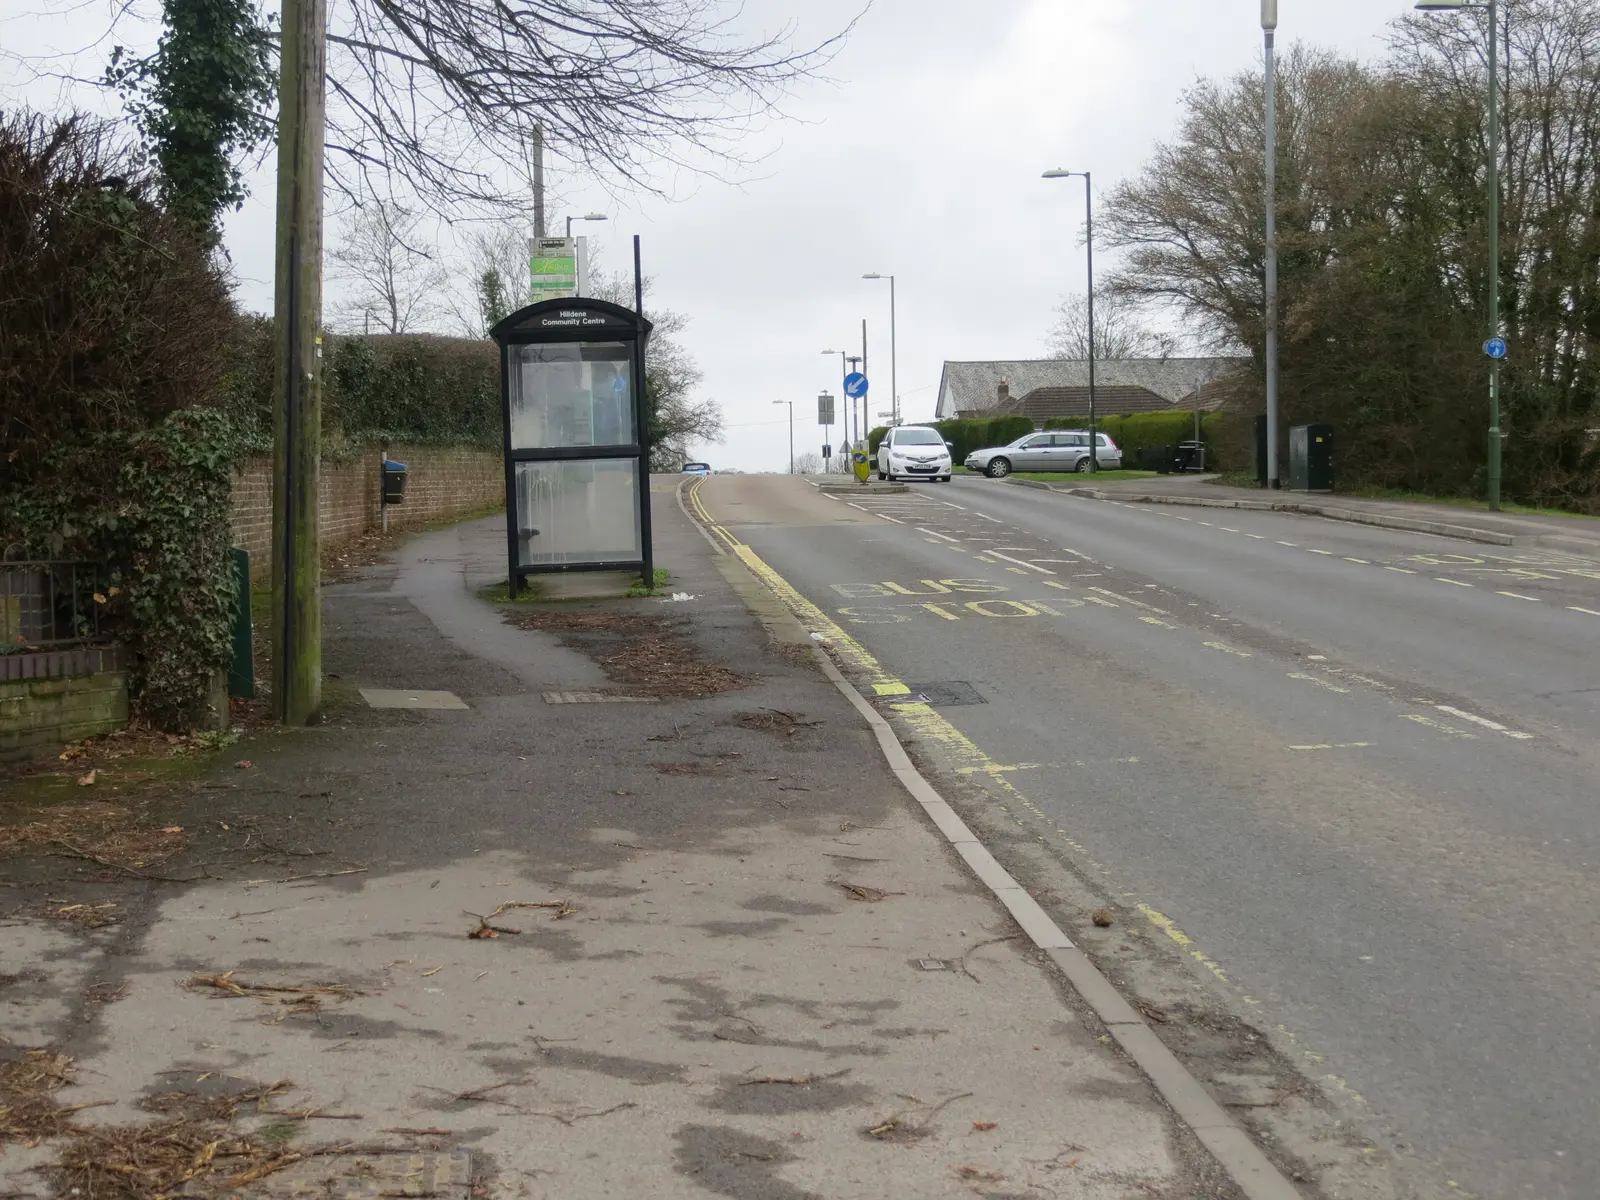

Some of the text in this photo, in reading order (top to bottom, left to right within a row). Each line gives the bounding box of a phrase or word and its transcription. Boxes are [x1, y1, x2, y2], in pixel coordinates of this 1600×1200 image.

[559, 310, 587, 318] Hilldene
[541, 317, 606, 326] Community Centre
[828, 578, 1010, 598] BUS
[837, 598, 1087, 624] STOP
